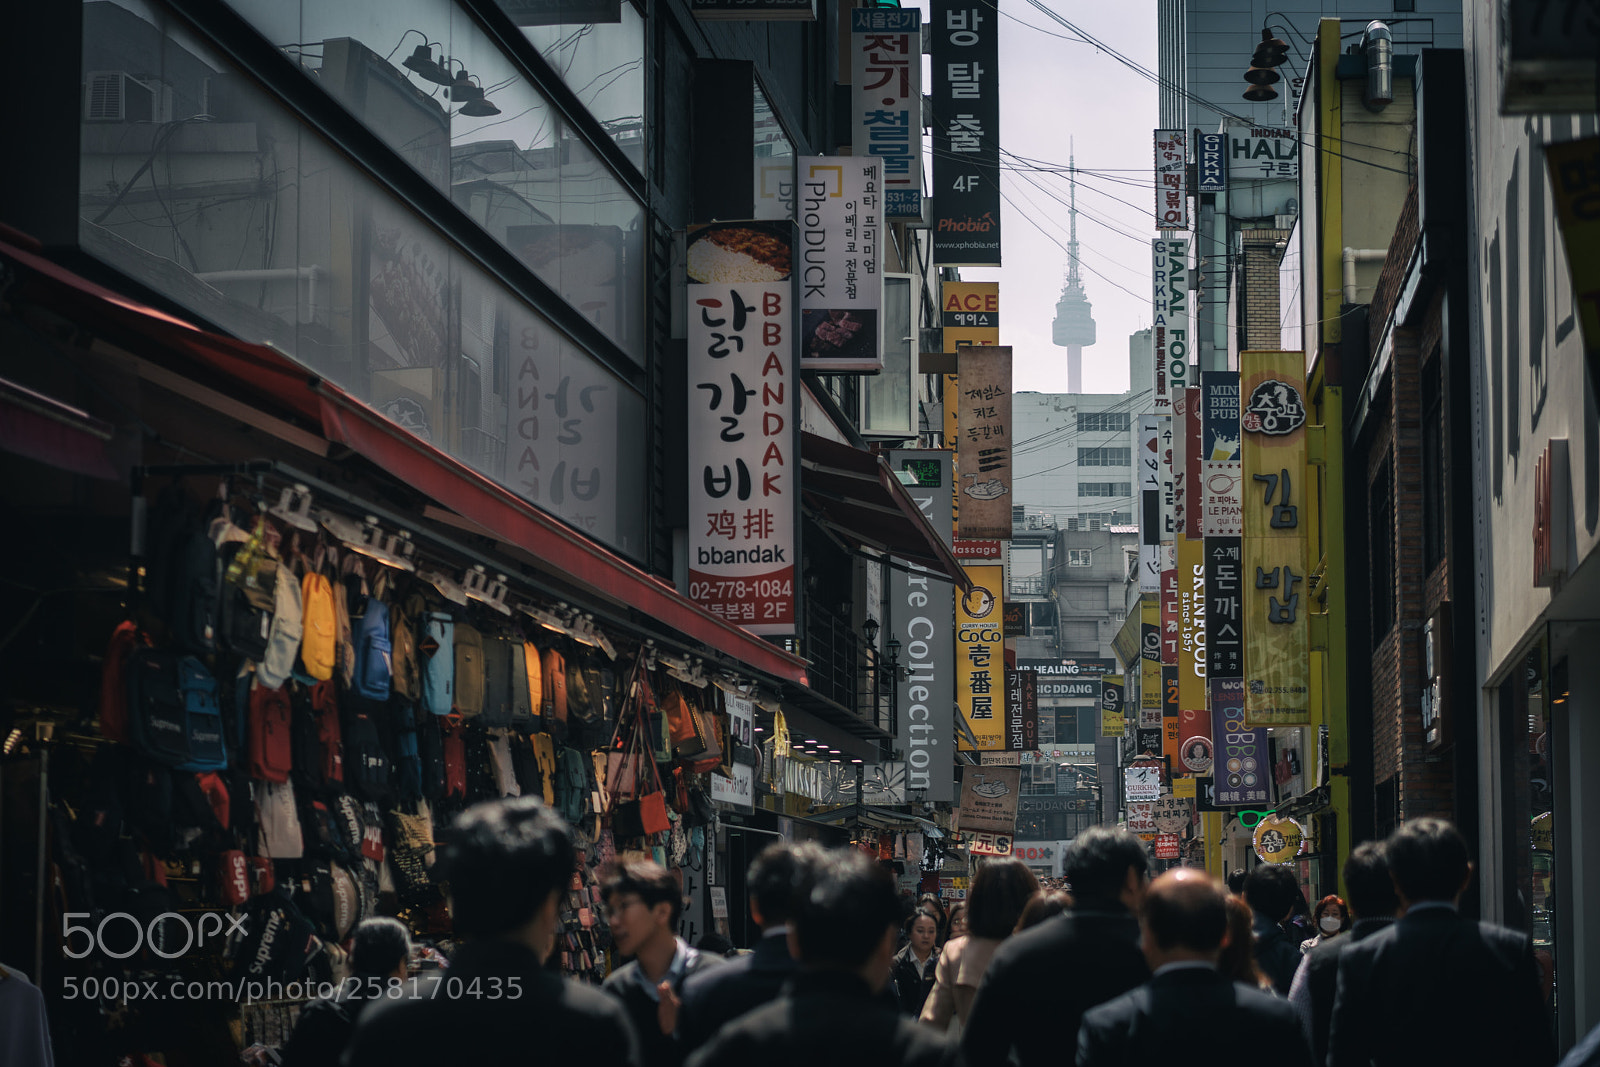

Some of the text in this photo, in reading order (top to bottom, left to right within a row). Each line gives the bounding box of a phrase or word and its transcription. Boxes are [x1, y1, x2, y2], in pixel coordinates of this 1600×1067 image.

[857, 12, 917, 29] 서울전기
[946, 8, 985, 152] 방탈출
[1202, 135, 1221, 184] GURKHA
[953, 175, 981, 193] 4F
[937, 217, 991, 232] Phobia
[845, 200, 859, 300] 이베리코 전문점
[863, 216, 878, 274] 프리미엄
[936, 240, 1000, 253] www.xphobia.net
[1155, 241, 1166, 326] GURKHA
[1169, 242, 1184, 317] HALAL
[946, 294, 998, 312] ACE
[954, 313, 989, 326] 에이스
[696, 289, 757, 501] 닭갈비
[762, 291, 784, 497] BBANDAK
[965, 384, 1006, 401] 제임스
[1209, 385, 1240, 396] MIN
[973, 407, 998, 419] 치즈
[1209, 409, 1238, 419] PUB
[1218, 496, 1238, 504] 피아노
[1208, 506, 1220, 516] LE
[705, 508, 774, 541] 鸡排
[1216, 516, 1230, 526] qui
[697, 545, 786, 565] bbandak
[1212, 546, 1239, 561] 수제
[1253, 469, 1303, 625] 김밥
[689, 580, 792, 600] 02-778-1084
[701, 602, 787, 620] 동본점 2F
[1213, 565, 1240, 645] 돈까스
[1182, 592, 1194, 653] since 1957
[1053, 684, 1093, 694] DDANG
[907, 616, 938, 792] Collection
[1009, 672, 1024, 750] 카레전문점
[1025, 673, 1034, 748] TAKE OUT
[1157, 799, 1185, 809] 의정부
[1153, 809, 1190, 820] 부대찌개
